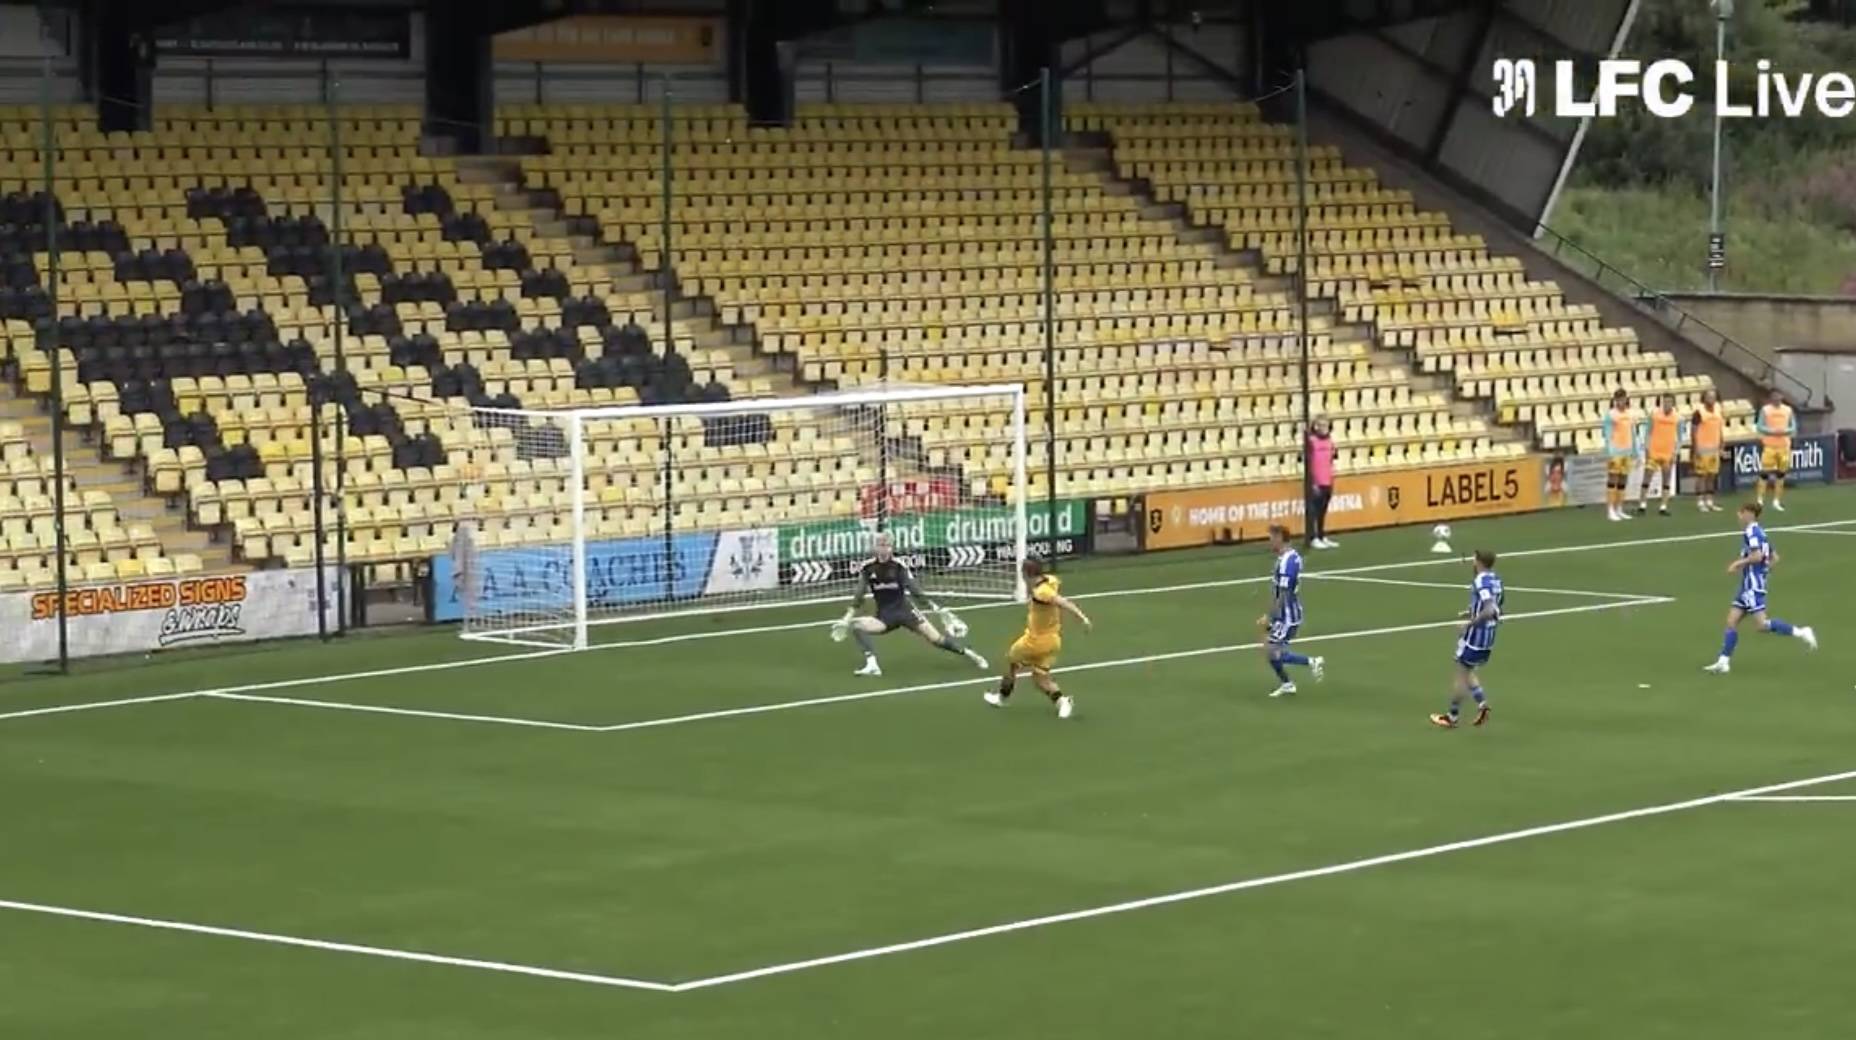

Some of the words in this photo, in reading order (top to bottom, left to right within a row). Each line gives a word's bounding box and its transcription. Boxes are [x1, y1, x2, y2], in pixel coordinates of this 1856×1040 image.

[1734, 444, 1763, 473] Kelv
[1790, 440, 1823, 470] mith
[1189, 505, 1226, 526] HOME
[790, 517, 924, 559] drummnd
[32, 582, 177, 620] SPECIALIZED
[178, 576, 247, 606] SIGNS
